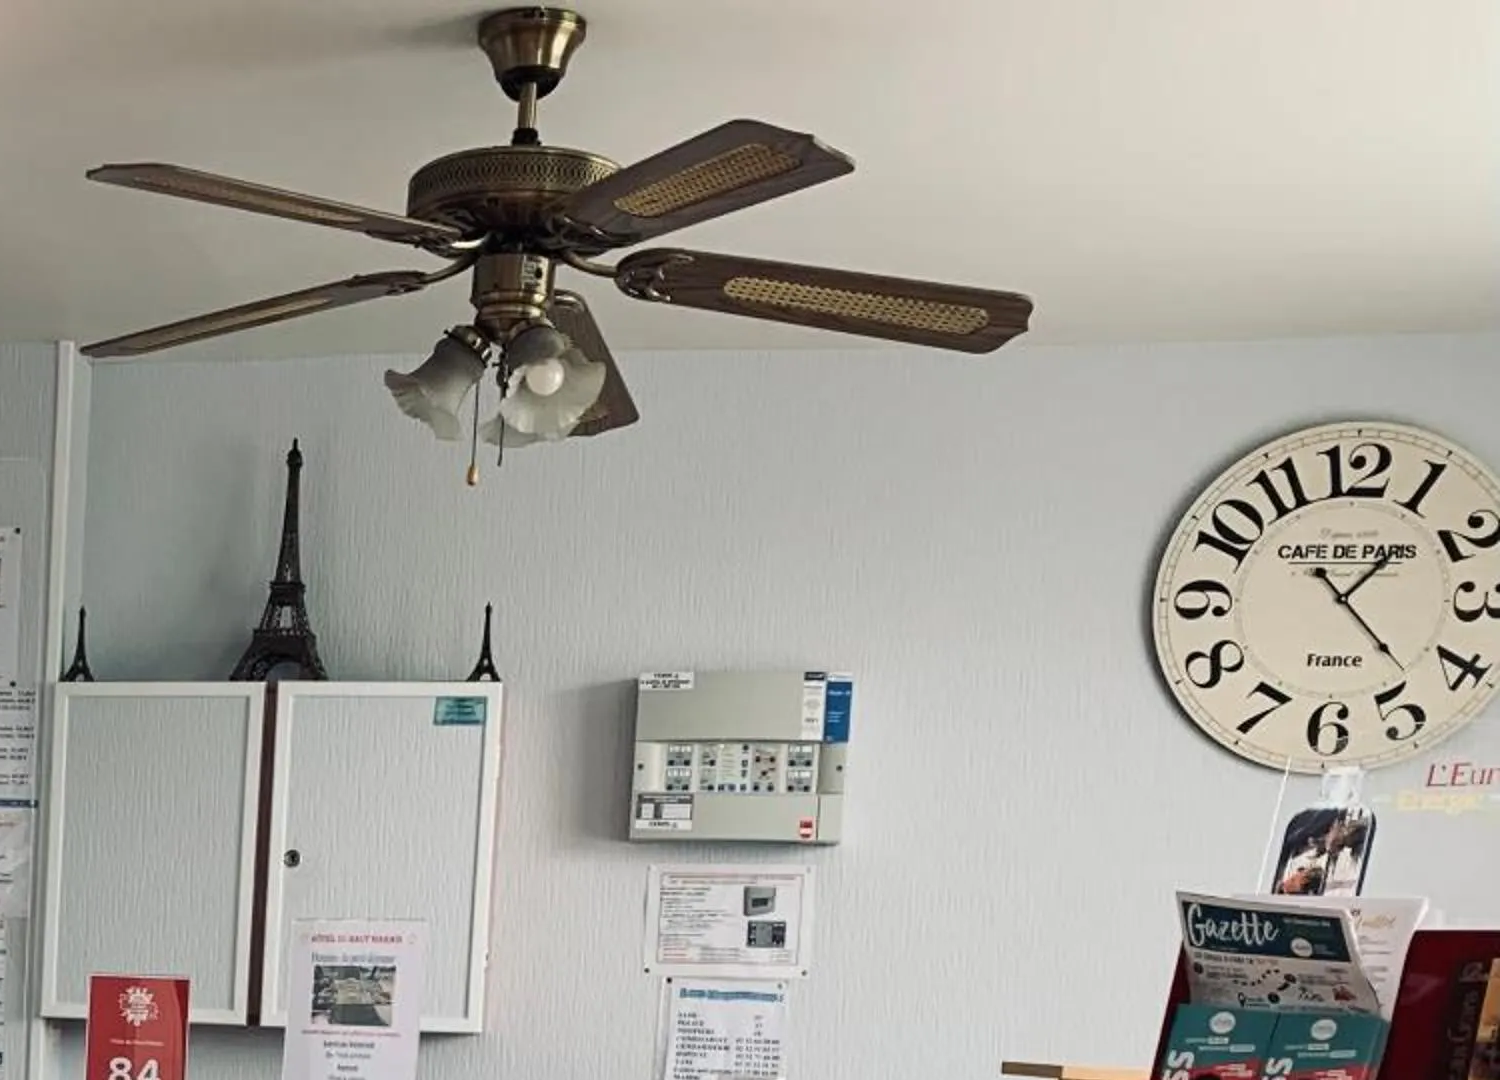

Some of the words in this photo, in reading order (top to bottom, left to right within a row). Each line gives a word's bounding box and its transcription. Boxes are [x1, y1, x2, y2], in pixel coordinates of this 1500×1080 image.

[1246, 456, 1323, 525] 11
[1316, 442, 1392, 498] 12
[1392, 459, 1447, 519] 1
[1194, 499, 1264, 573] 10
[1332, 544, 1357, 559] DE
[1361, 544, 1418, 559] PARIS
[1438, 509, 1500, 563] 2
[1174, 580, 1233, 620] 9
[1453, 581, 1500, 622] 3
[1185, 640, 1245, 688] 8
[1307, 653, 1363, 668] France
[1437, 645, 1493, 692] 4
[1236, 681, 1292, 735] 7
[1307, 701, 1349, 756] 6
[1374, 680, 1427, 741] 5
[1188, 903, 1280, 947] Gazette
